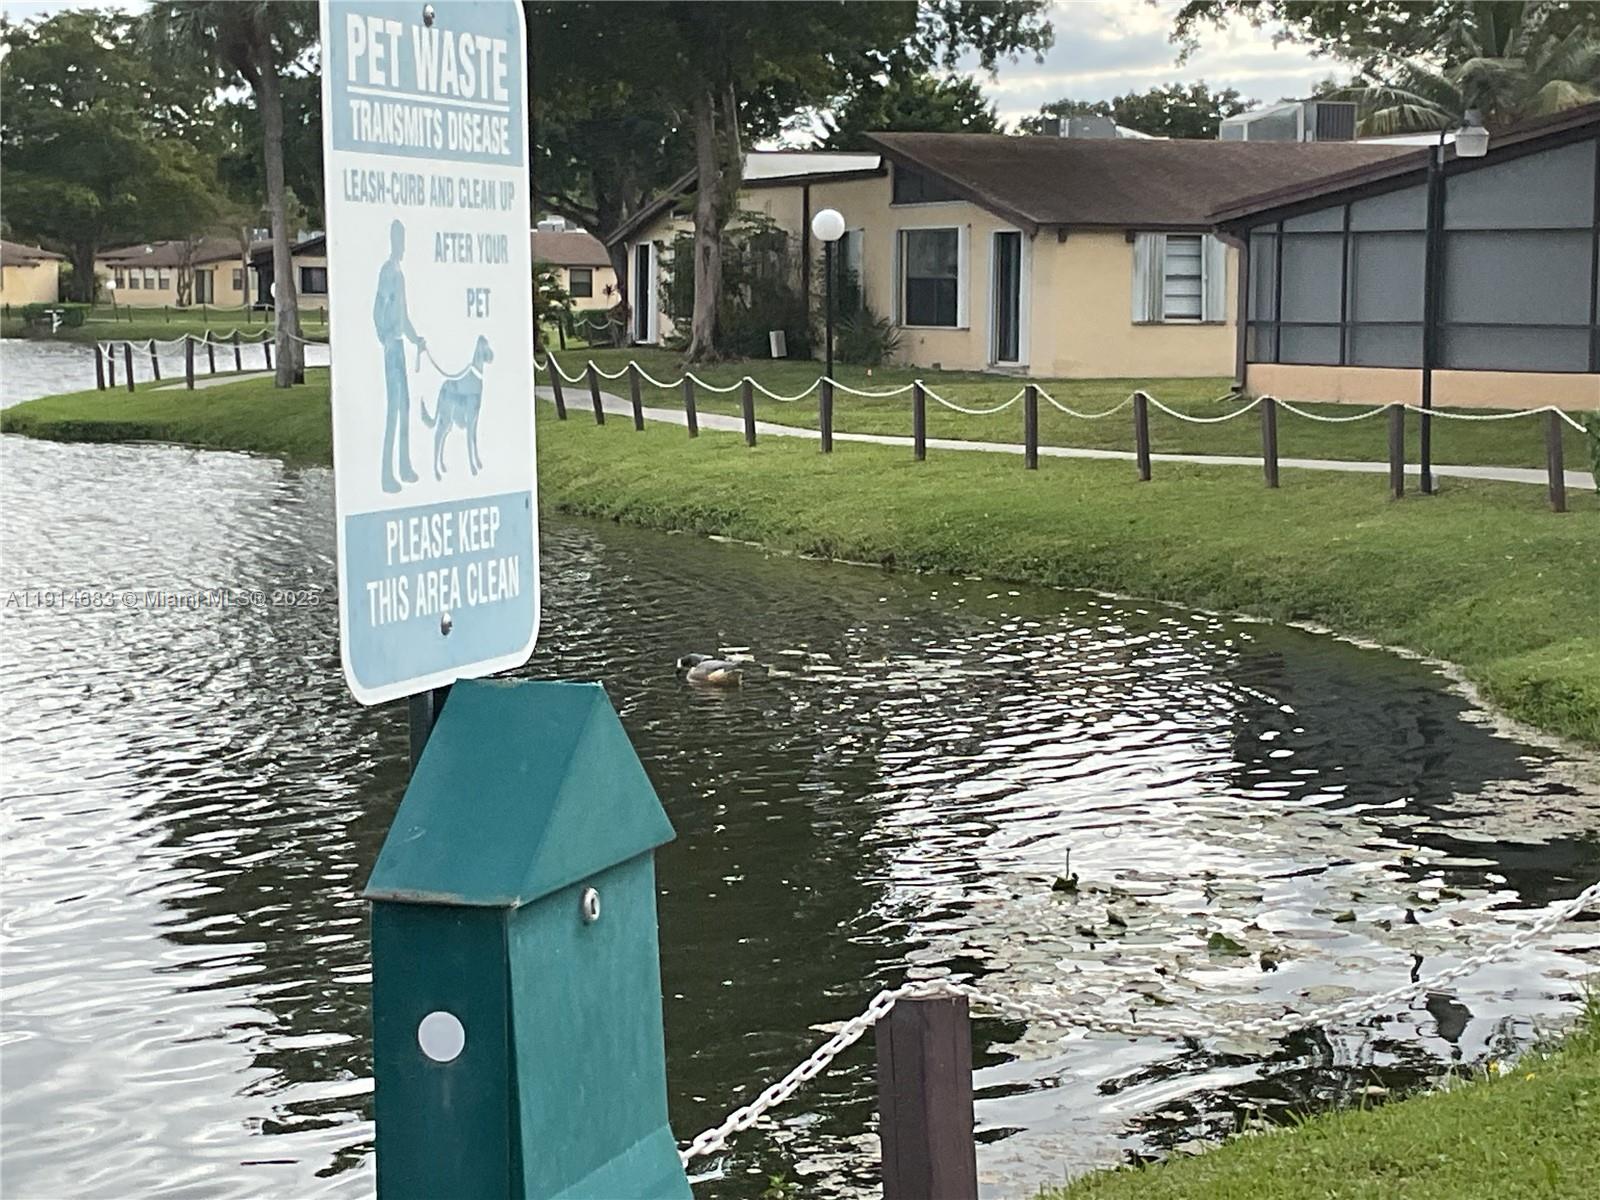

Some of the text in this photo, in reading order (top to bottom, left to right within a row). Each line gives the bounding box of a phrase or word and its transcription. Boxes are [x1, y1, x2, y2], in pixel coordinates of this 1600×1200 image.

[346, 13, 509, 101] PET WASTE
[349, 99, 511, 155] TRANSMITS DISEASE
[343, 168, 515, 211] LEASH-CURB AND CLEAN UP
[434, 231, 509, 264] AFTER YOUR
[466, 287, 491, 318] PET
[386, 506, 500, 566] PLEASE KEEP
[366, 555, 519, 627] THIS AREA CLEAN
